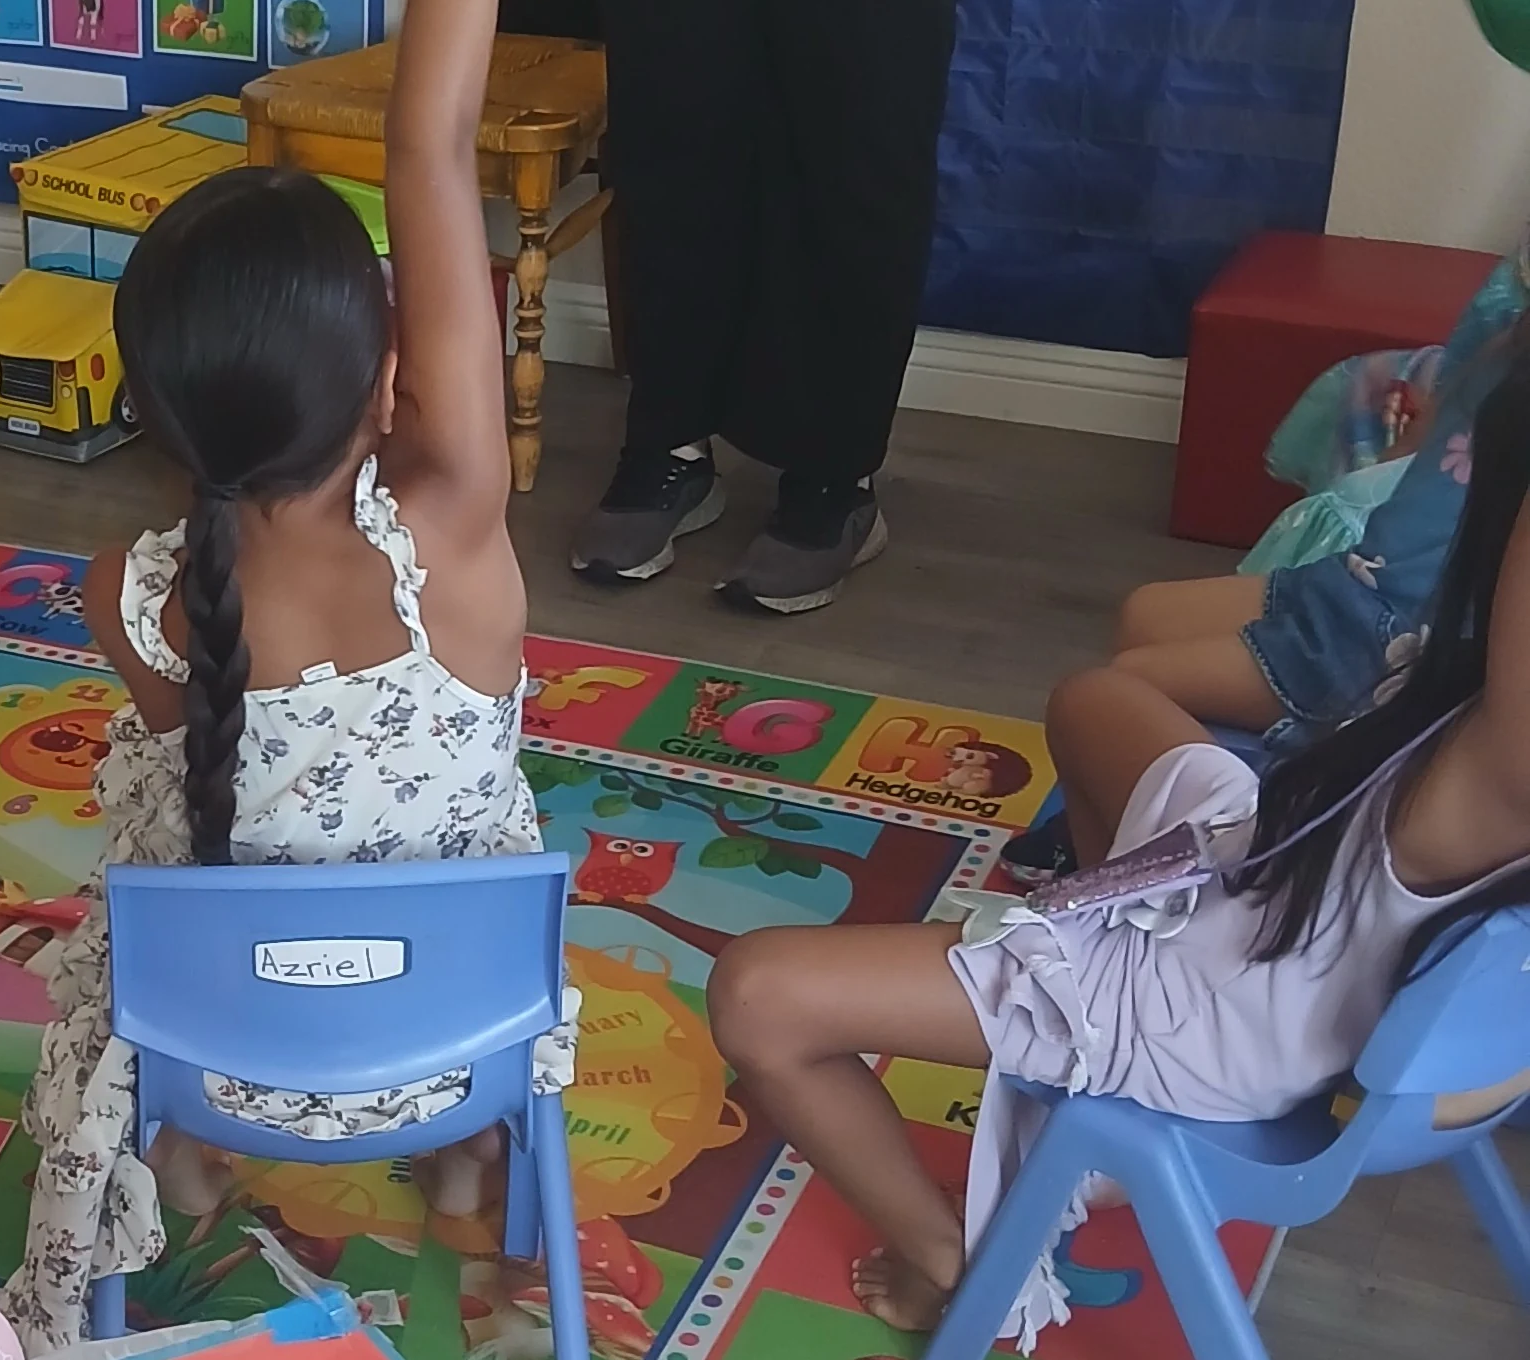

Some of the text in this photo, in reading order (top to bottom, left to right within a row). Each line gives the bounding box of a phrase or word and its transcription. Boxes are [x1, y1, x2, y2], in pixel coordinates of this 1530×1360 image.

[41, 173, 126, 206] SCHOOL BUS
[0, 693, 44, 711] 10
[520, 708, 557, 732] ox
[659, 737, 780, 774] Giraffe
[3, 794, 38, 815] 6
[845, 771, 1002, 820] Hedgehog
[261, 946, 375, 981] Azriel
